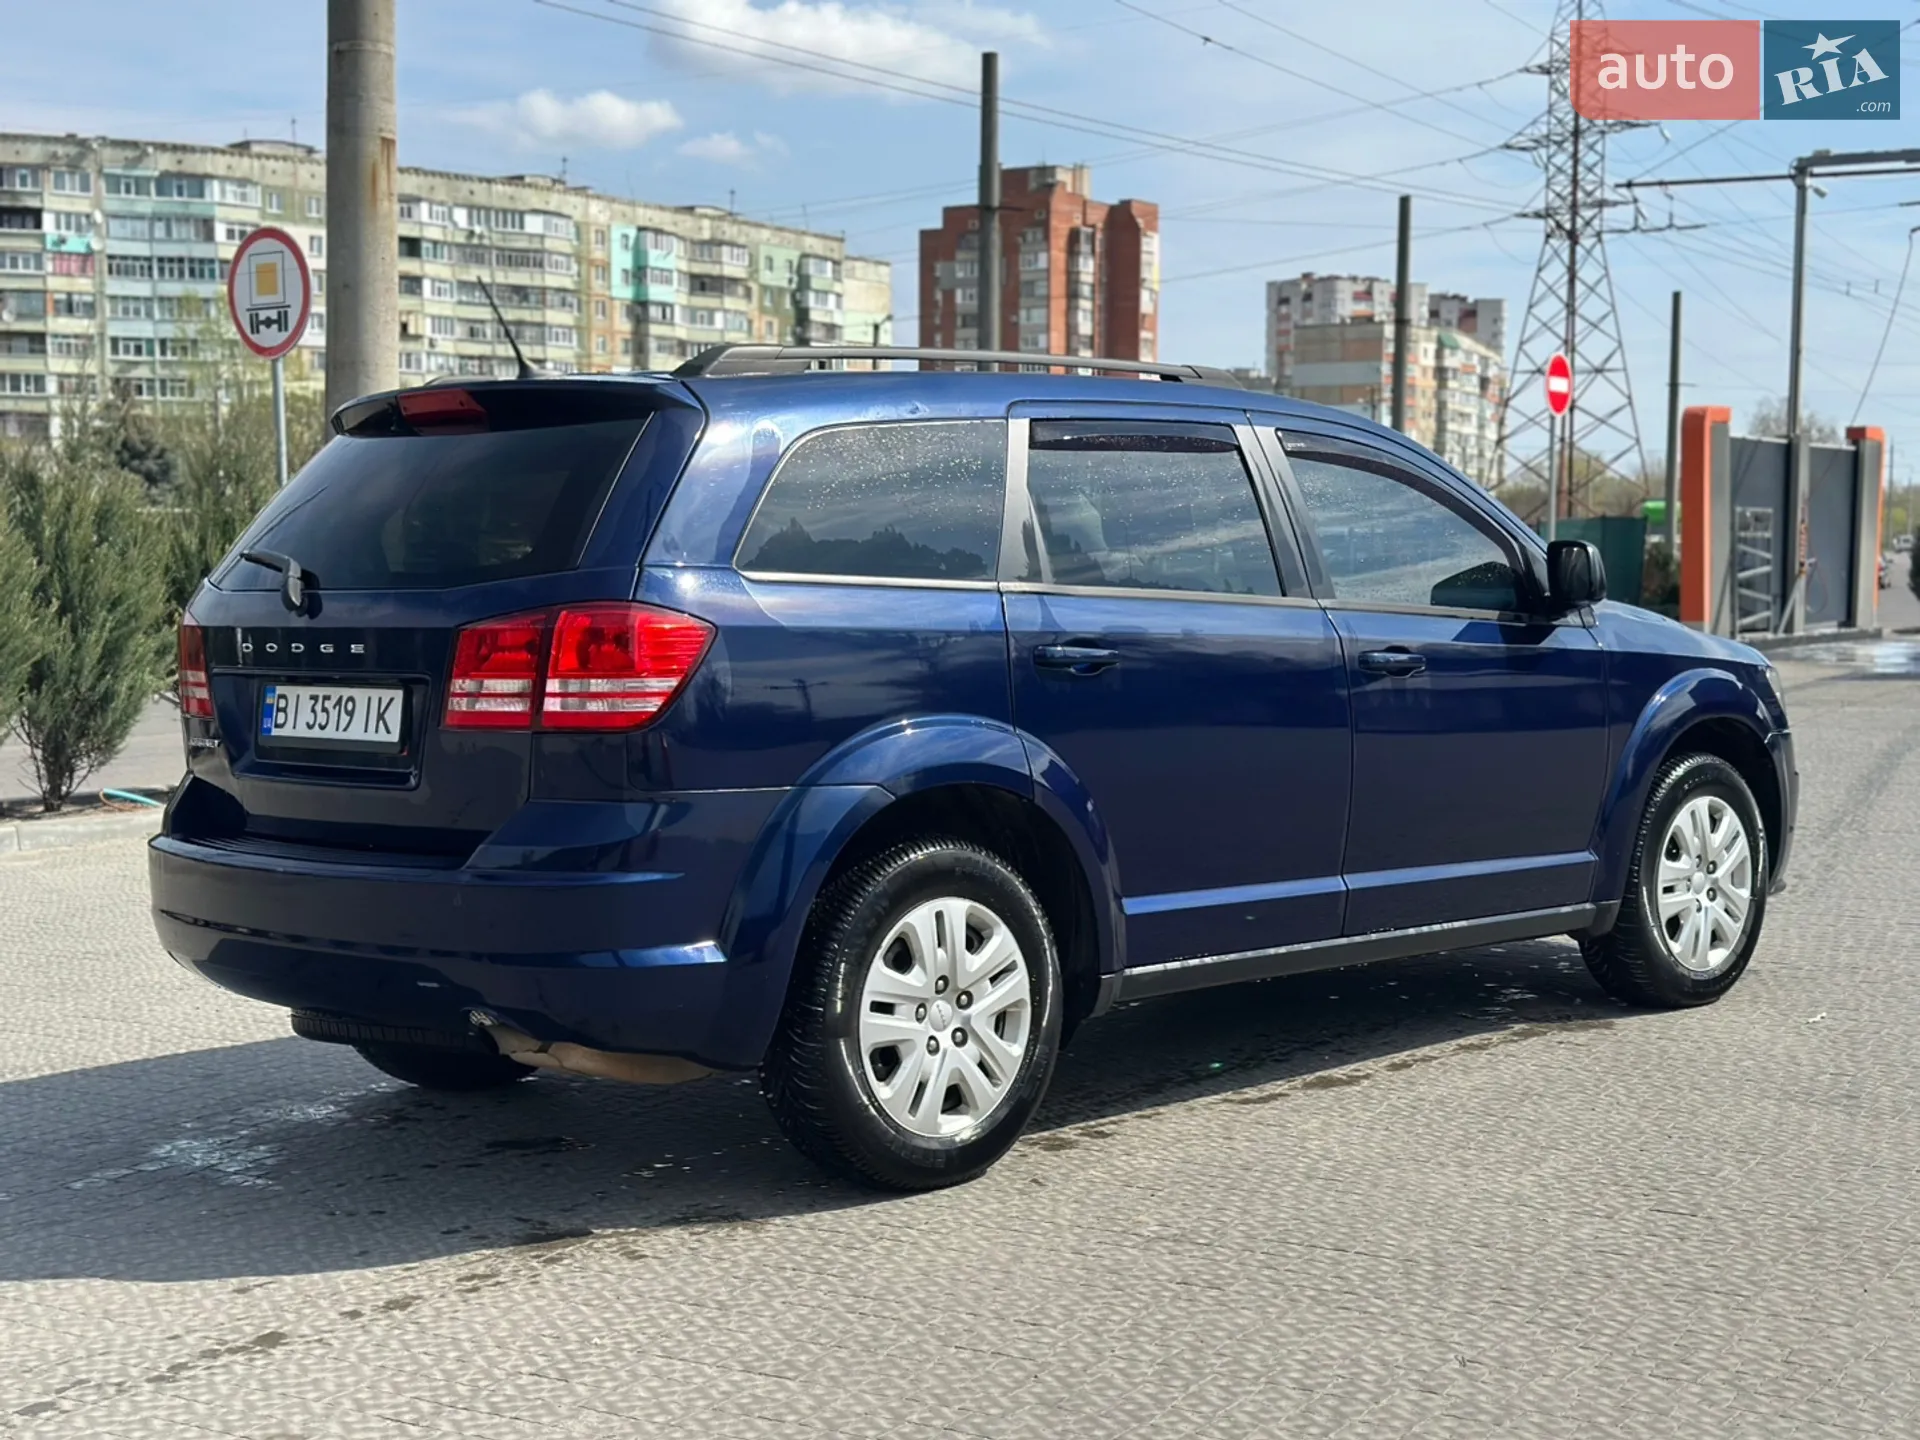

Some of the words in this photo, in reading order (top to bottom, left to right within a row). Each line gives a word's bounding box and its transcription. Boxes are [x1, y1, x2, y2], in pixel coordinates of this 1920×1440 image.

[242, 643, 365, 653] DODGE
[274, 693, 299, 730] BI
[305, 694, 356, 732] 3519
[364, 696, 396, 734] IK
